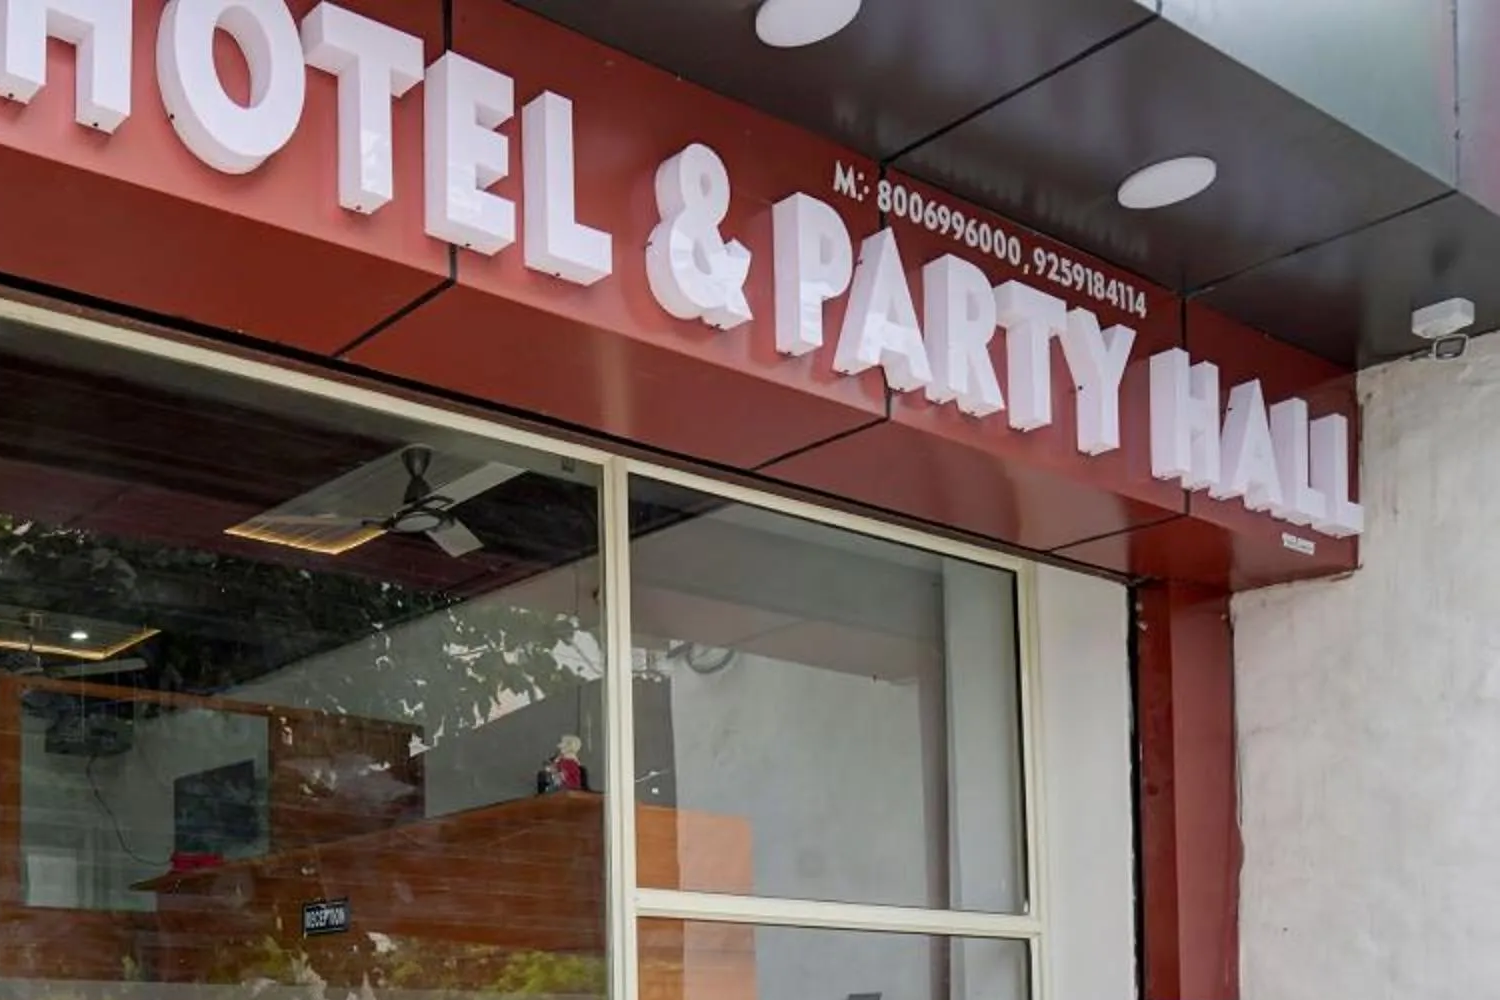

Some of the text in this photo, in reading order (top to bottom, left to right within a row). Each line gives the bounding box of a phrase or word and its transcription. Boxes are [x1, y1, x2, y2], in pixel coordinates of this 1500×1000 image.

[645, 143, 753, 330] &
[772, 192, 1136, 456] PARTY
[1150, 347, 1364, 539] HALL
[305, 907, 346, 929] RECEPTION
